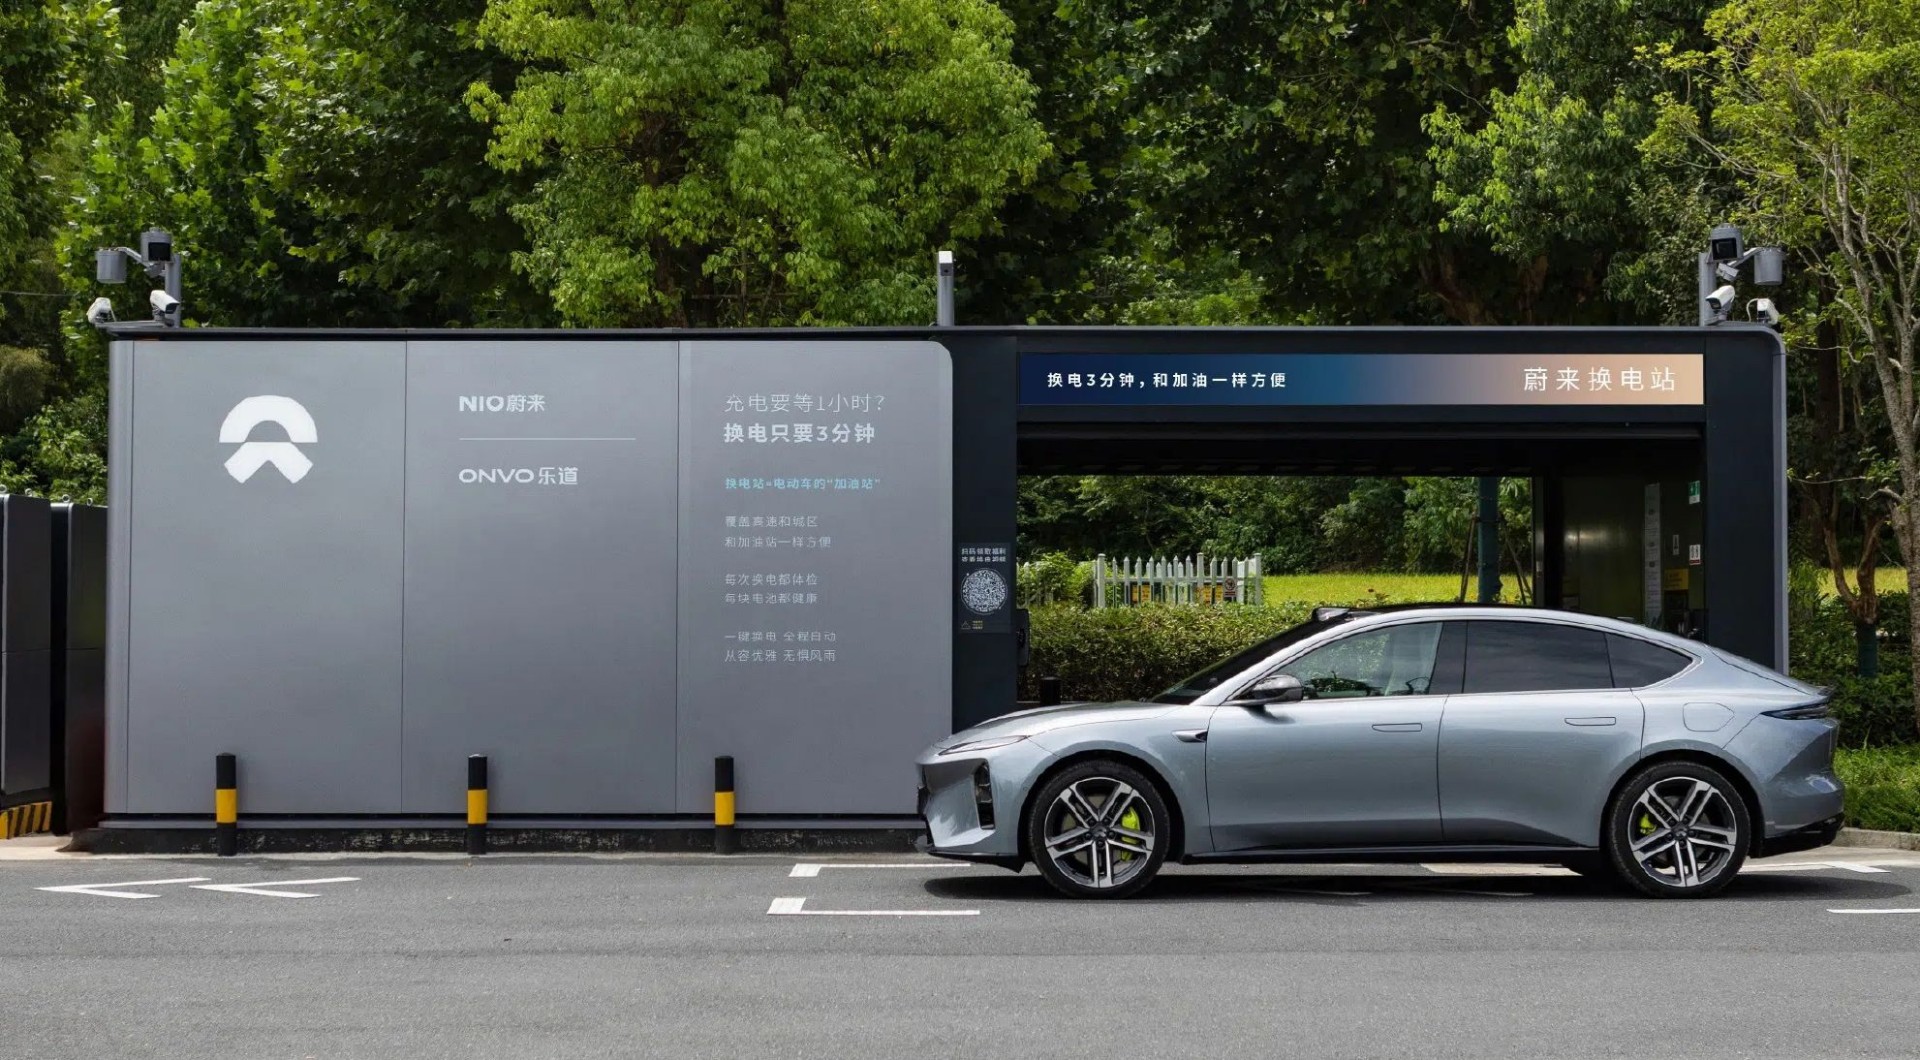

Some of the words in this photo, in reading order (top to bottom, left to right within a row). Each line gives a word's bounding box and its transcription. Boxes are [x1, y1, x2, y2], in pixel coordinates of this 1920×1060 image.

[1047, 372, 1286, 388] 换电3分钟，和加油一样方便
[1523, 366, 1676, 392] 蔚来换电站
[723, 423, 876, 443] 换电只要3分钟
[724, 515, 819, 528] 覆盖高速和城区
[724, 536, 832, 549] 和加油站一样方便
[724, 573, 818, 586] 每次换电都体检
[724, 592, 818, 605] 每块电池都健康
[724, 631, 777, 643] 一键换电
[783, 631, 836, 643] 全程自动
[724, 649, 777, 663] 从容优雅
[783, 649, 836, 663] 无惧风雨
